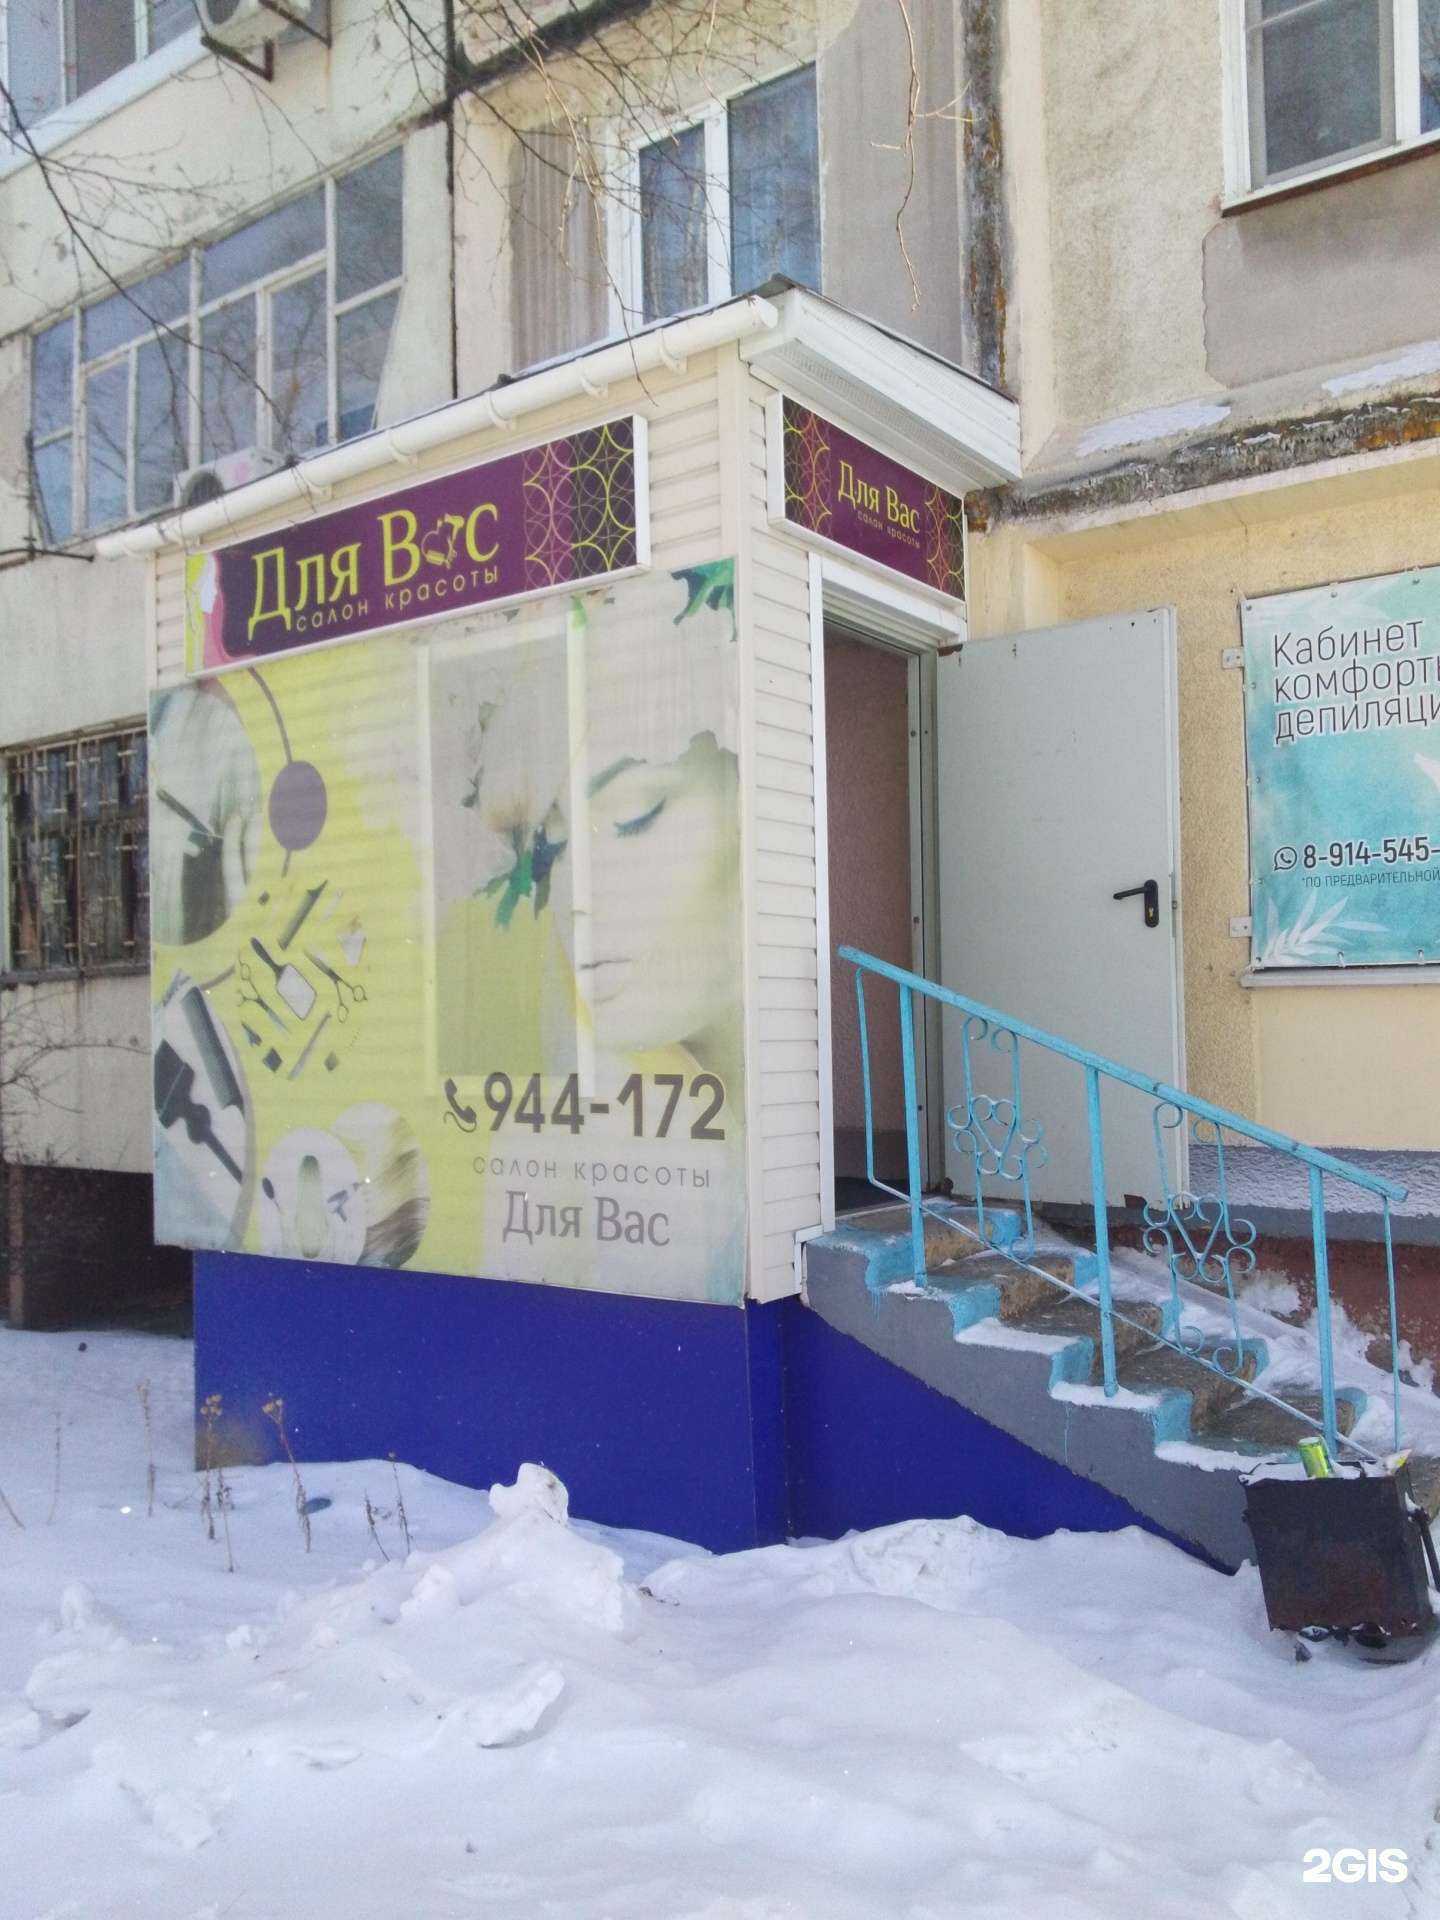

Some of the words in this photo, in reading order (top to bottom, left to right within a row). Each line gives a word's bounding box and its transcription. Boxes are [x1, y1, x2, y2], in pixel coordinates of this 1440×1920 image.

[838, 461, 879, 513] Для
[885, 485, 920, 534] Вас
[248, 543, 361, 641] Для
[297, 602, 368, 632] салон
[385, 565, 498, 608] красоты
[1274, 619, 1423, 668] Кабинет
[484, 1071, 726, 1141] 944-172
[472, 1155, 557, 1179] салон
[574, 1160, 710, 1188] красоты
[502, 1190, 583, 1246] Для
[594, 1196, 671, 1247] Вас
